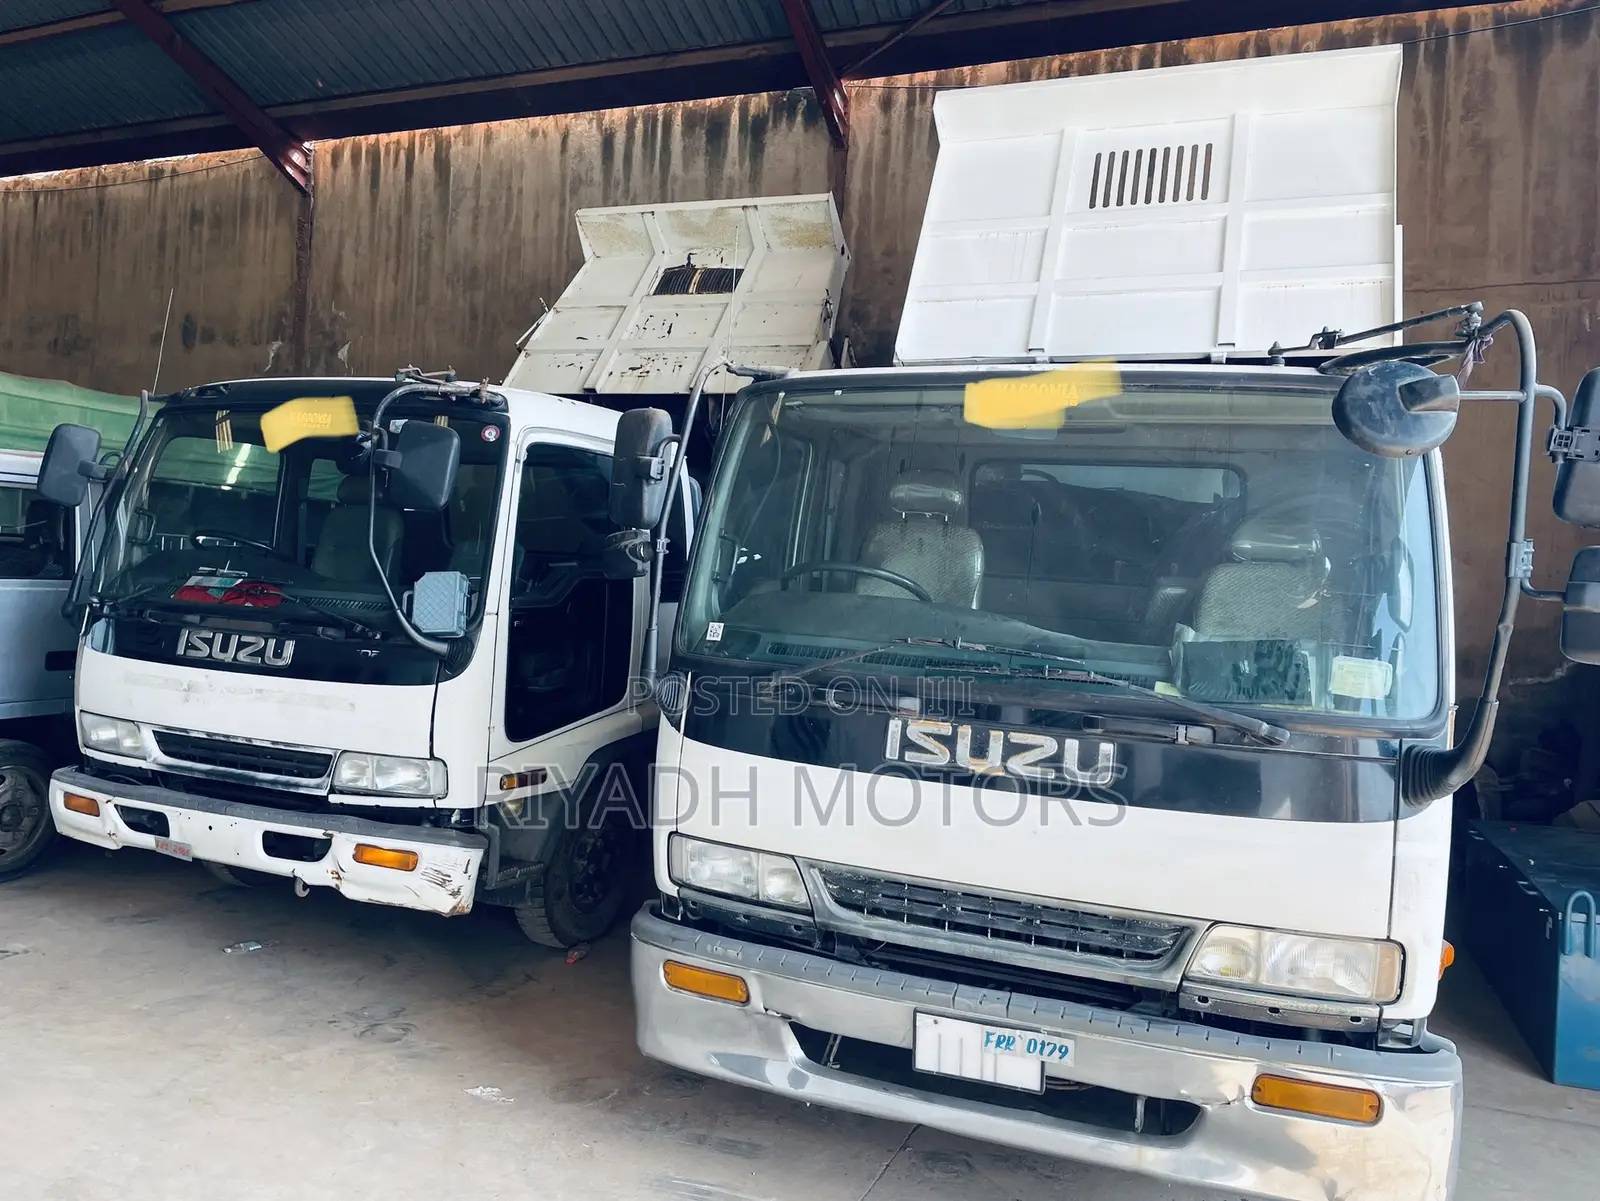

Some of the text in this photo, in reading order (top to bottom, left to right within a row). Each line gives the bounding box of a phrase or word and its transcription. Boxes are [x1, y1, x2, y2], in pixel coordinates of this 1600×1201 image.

[176, 628, 296, 668] ISUZU
[885, 718, 1116, 785] ISUZU
[984, 1031, 1070, 1060] FRR 0179
